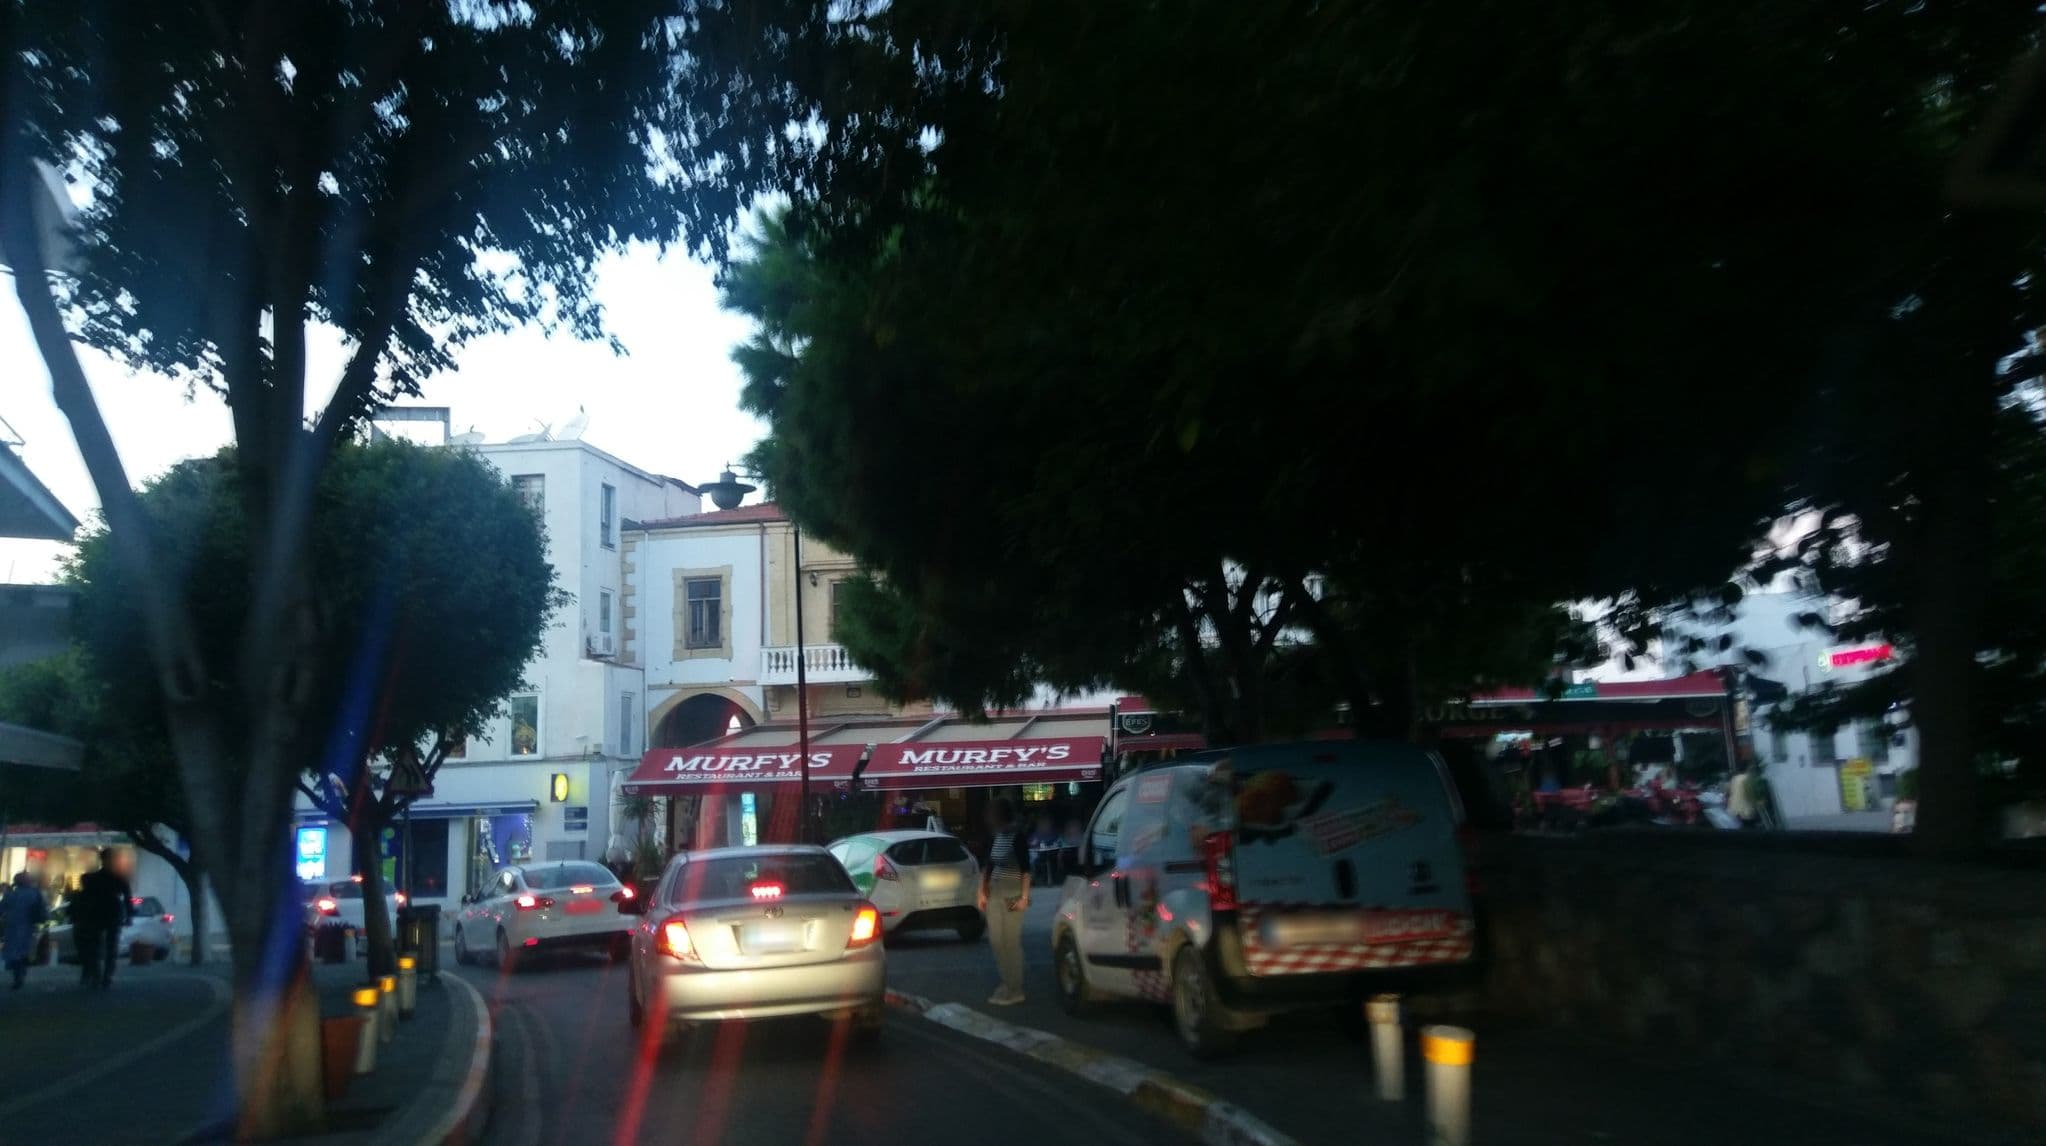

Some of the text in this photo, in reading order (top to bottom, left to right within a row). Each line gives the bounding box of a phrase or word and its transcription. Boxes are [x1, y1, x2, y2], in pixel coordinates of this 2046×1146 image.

[663, 752, 833, 771] MURFYS
[899, 745, 1070, 764] MURFY'S
[914, 763, 1004, 772] RESTAURANT
[676, 771, 764, 780] RESTAURANT
